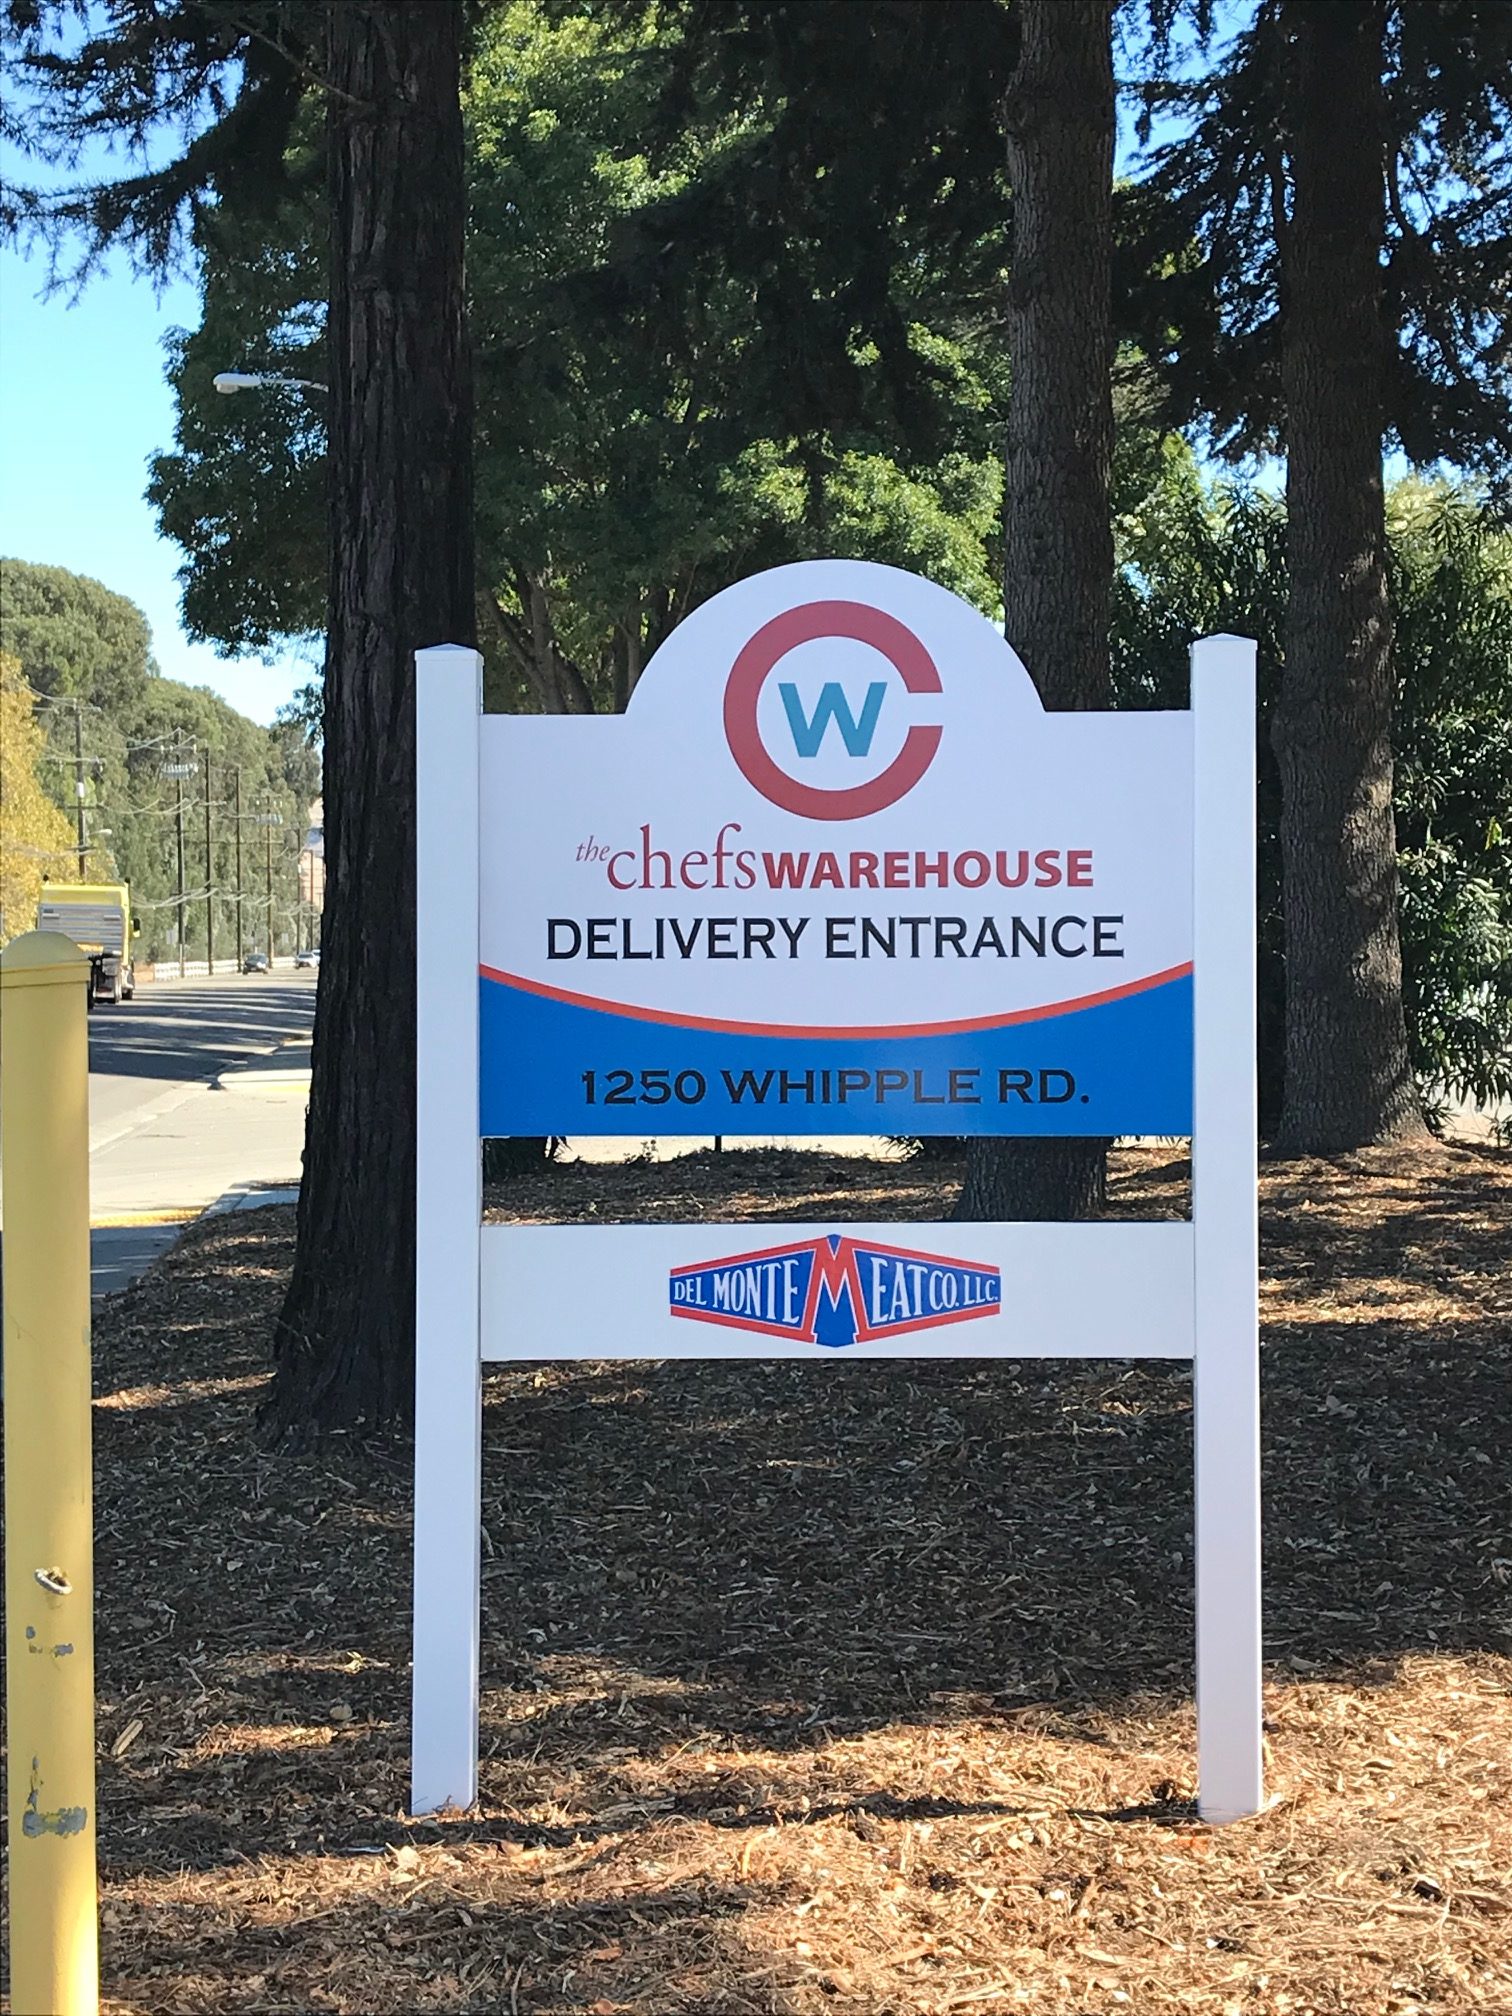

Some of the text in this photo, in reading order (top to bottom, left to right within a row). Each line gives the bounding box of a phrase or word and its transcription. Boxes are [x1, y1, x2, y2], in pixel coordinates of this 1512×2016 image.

[576, 823, 1095, 891] the chefs WAREHOUSE
[546, 915, 1125, 960] DELIVERY ENTRANCE
[580, 1069, 1090, 1104] 1250 WHIPPLE RD.
[673, 1272, 707, 1306] DEL
[712, 1259, 800, 1324] MONTE
[929, 1270, 960, 1311] CO.
[962, 1274, 998, 1306] LLC.
